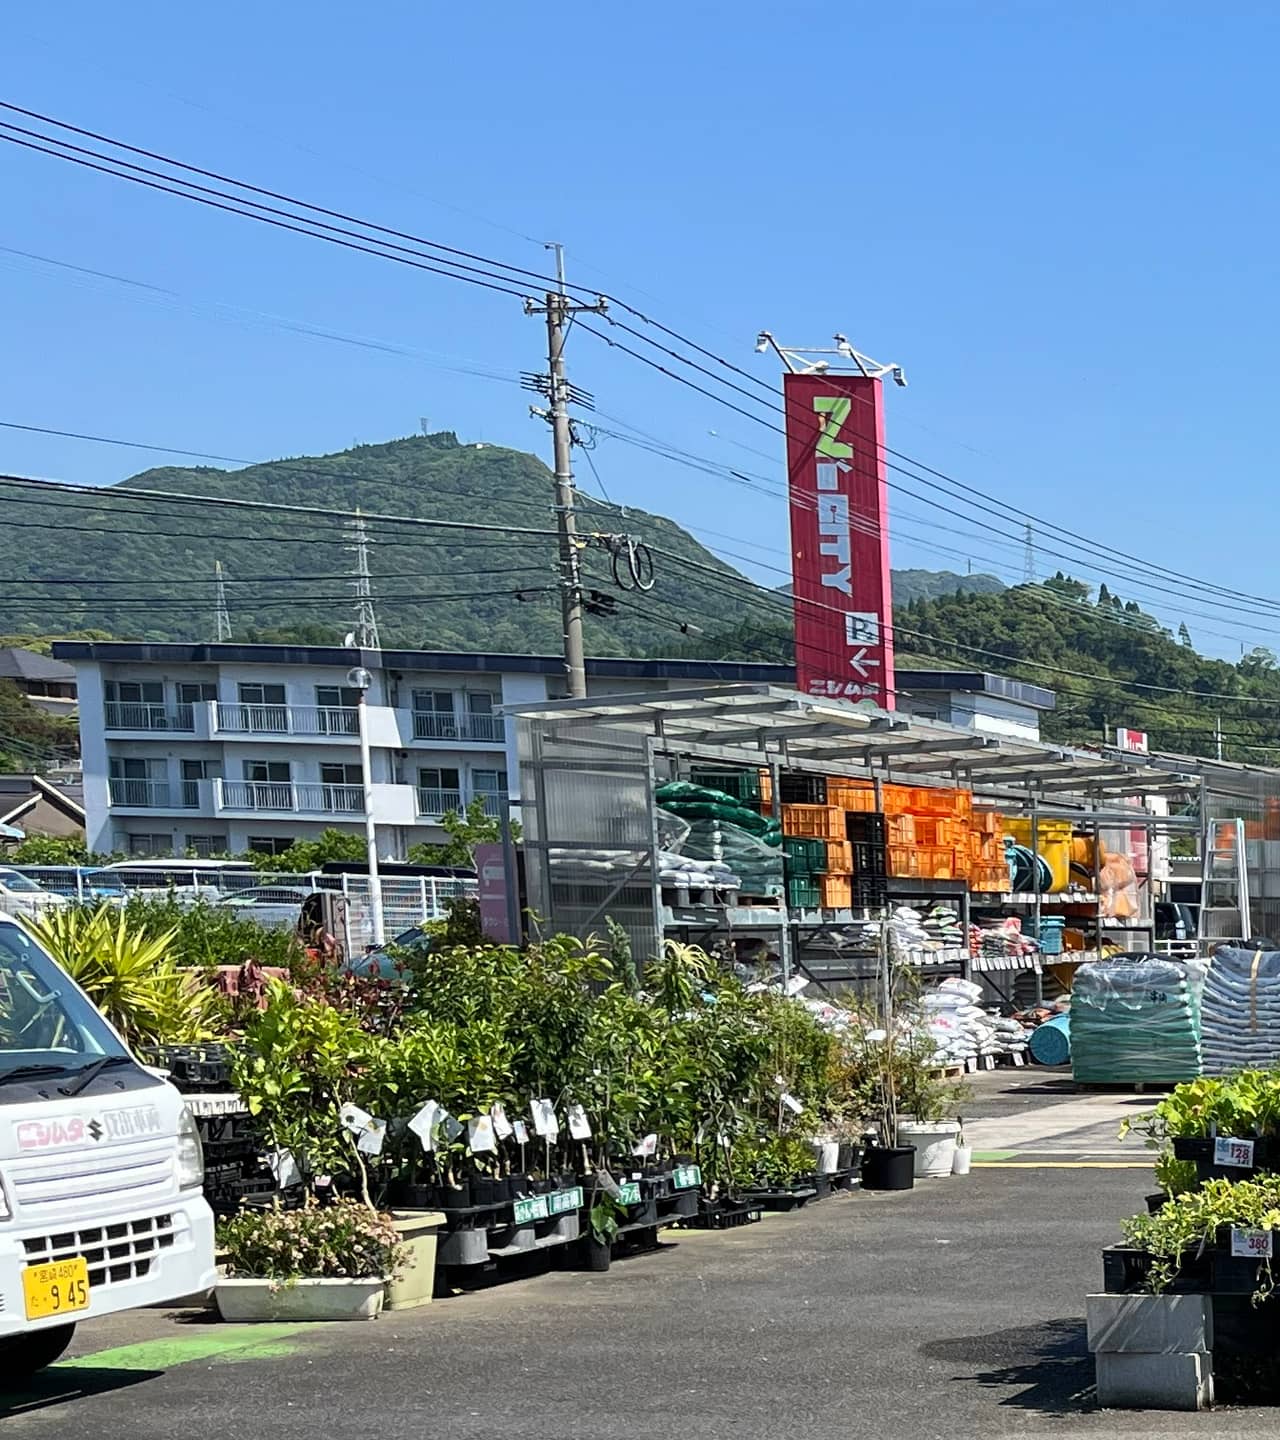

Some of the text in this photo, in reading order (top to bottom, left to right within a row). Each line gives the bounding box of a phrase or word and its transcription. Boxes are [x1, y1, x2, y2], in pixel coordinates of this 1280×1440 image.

[817, 494, 853, 598] CITY
[16, 1117, 85, 1148] ニシムタ
